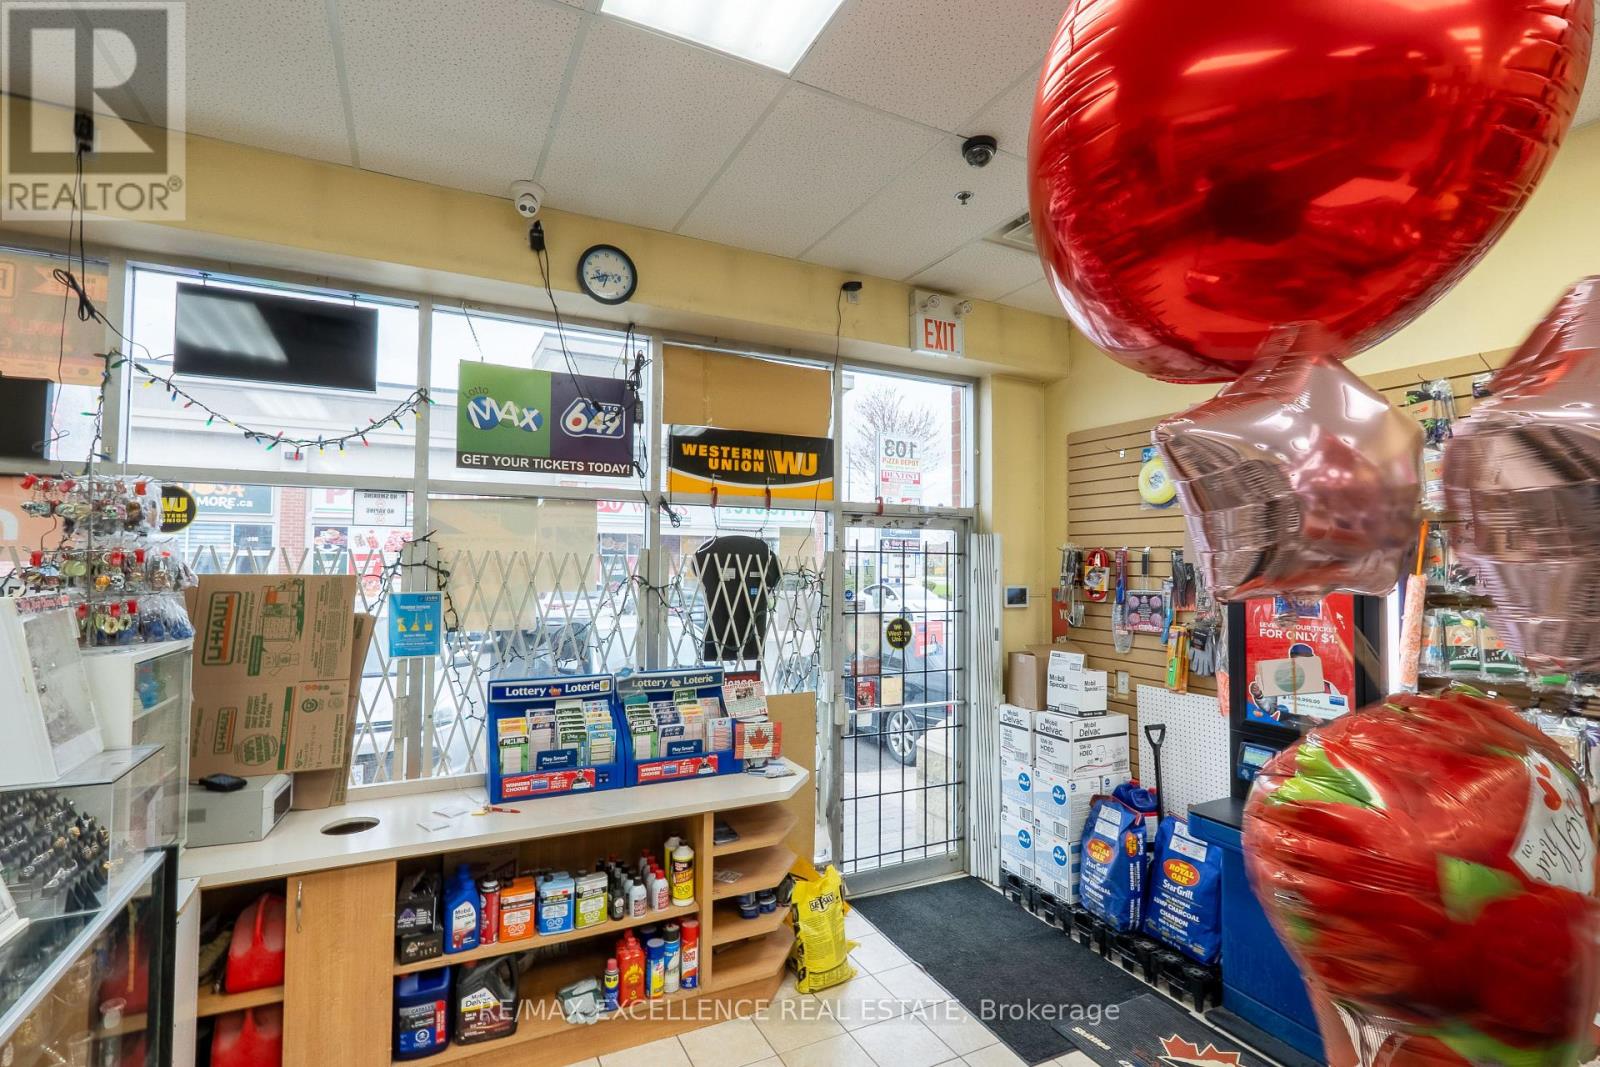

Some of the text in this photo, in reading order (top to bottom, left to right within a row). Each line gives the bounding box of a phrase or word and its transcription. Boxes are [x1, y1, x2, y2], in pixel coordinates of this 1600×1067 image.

[924, 318, 956, 352] EXIT
[681, 443, 764, 461] WESTERN
[462, 454, 630, 474] GET YOUR TICKETS TODAY!
[708, 457, 764, 473] UNION
[773, 450, 818, 476] WU
[207, 596, 230, 661] U-HAUL
[1259, 628, 1338, 644] FOR ONLY $1.
[632, 674, 713, 688] Lottery Loterie
[1049, 673, 1065, 682] Mobil
[1049, 681, 1068, 689] Special
[505, 681, 600, 697] Lottery Loterie
[1003, 713, 1023, 726] Delvac
[1044, 718, 1058, 727] Mobil
[1040, 722, 1063, 737] Delvac
[1079, 727, 1101, 737] Delvac
[1168, 864, 1195, 880] ROYAL
[1171, 873, 1189, 885] OAK
[1162, 879, 1194, 900] StarGrill
[1159, 909, 1189, 927] CHARBON
[1168, 903, 1200, 923] CHARCOAL
